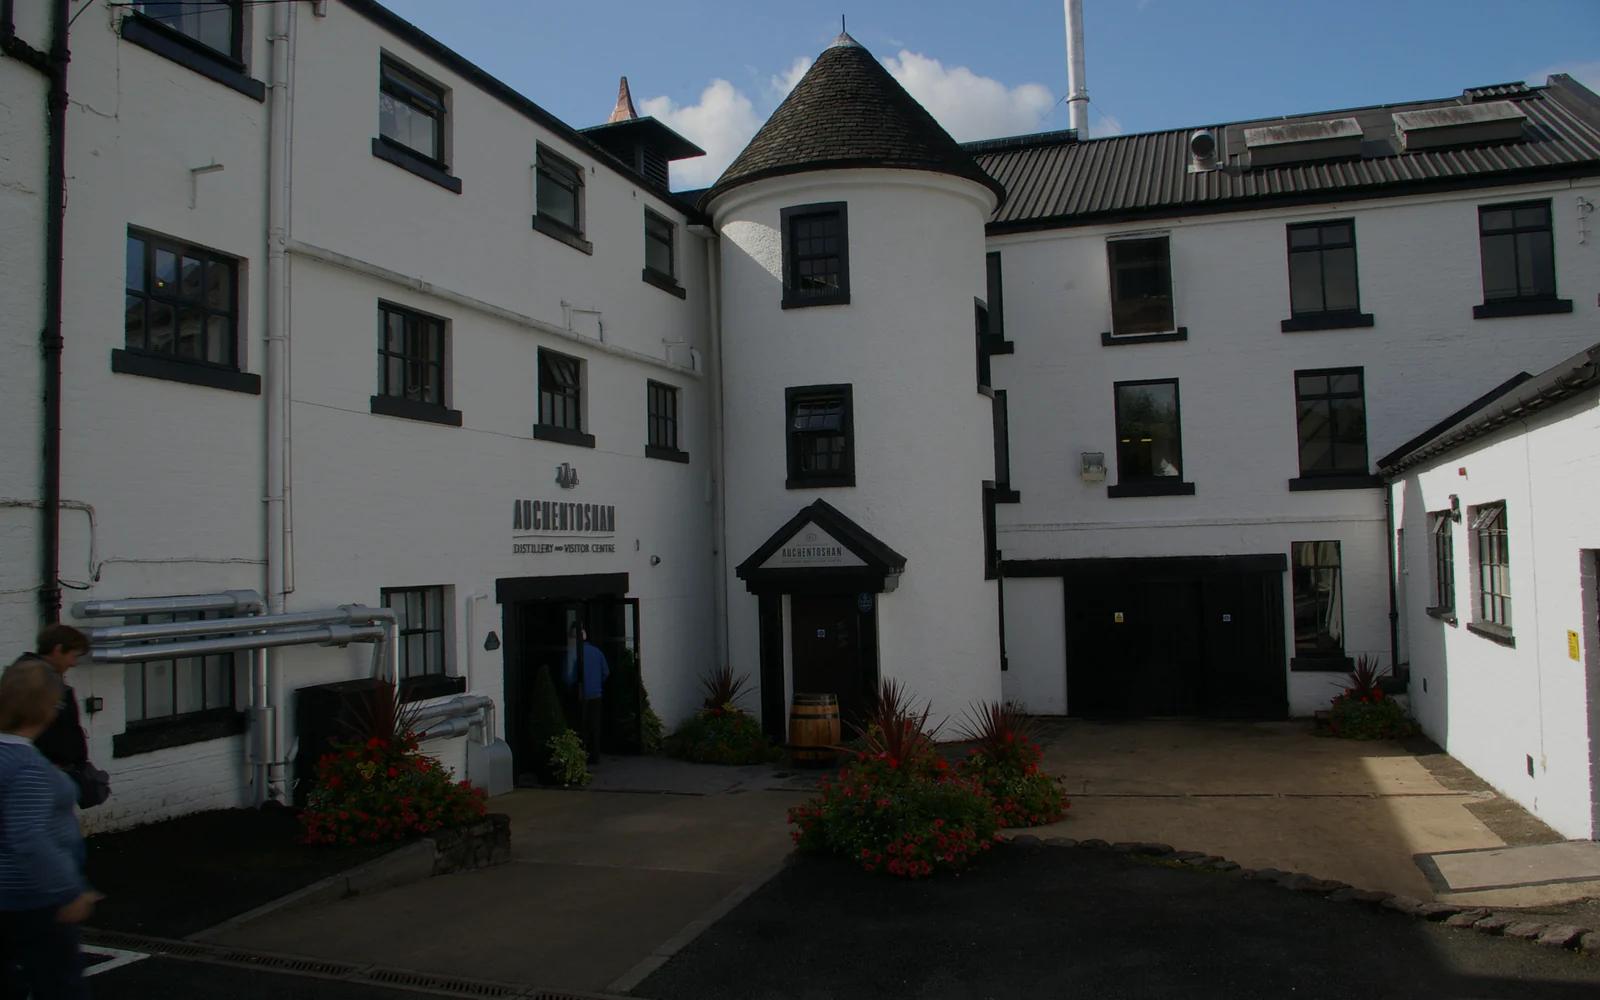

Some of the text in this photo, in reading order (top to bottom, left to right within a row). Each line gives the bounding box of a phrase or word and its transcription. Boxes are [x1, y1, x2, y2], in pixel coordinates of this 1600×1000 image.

[513, 499, 615, 532] AUCHENTOSHAN
[513, 543, 554, 554] DISTILLERY
[564, 543, 590, 553] VISITOR
[592, 544, 615, 553] CENTRE
[782, 547, 842, 558] AUCHENTOSHAN
